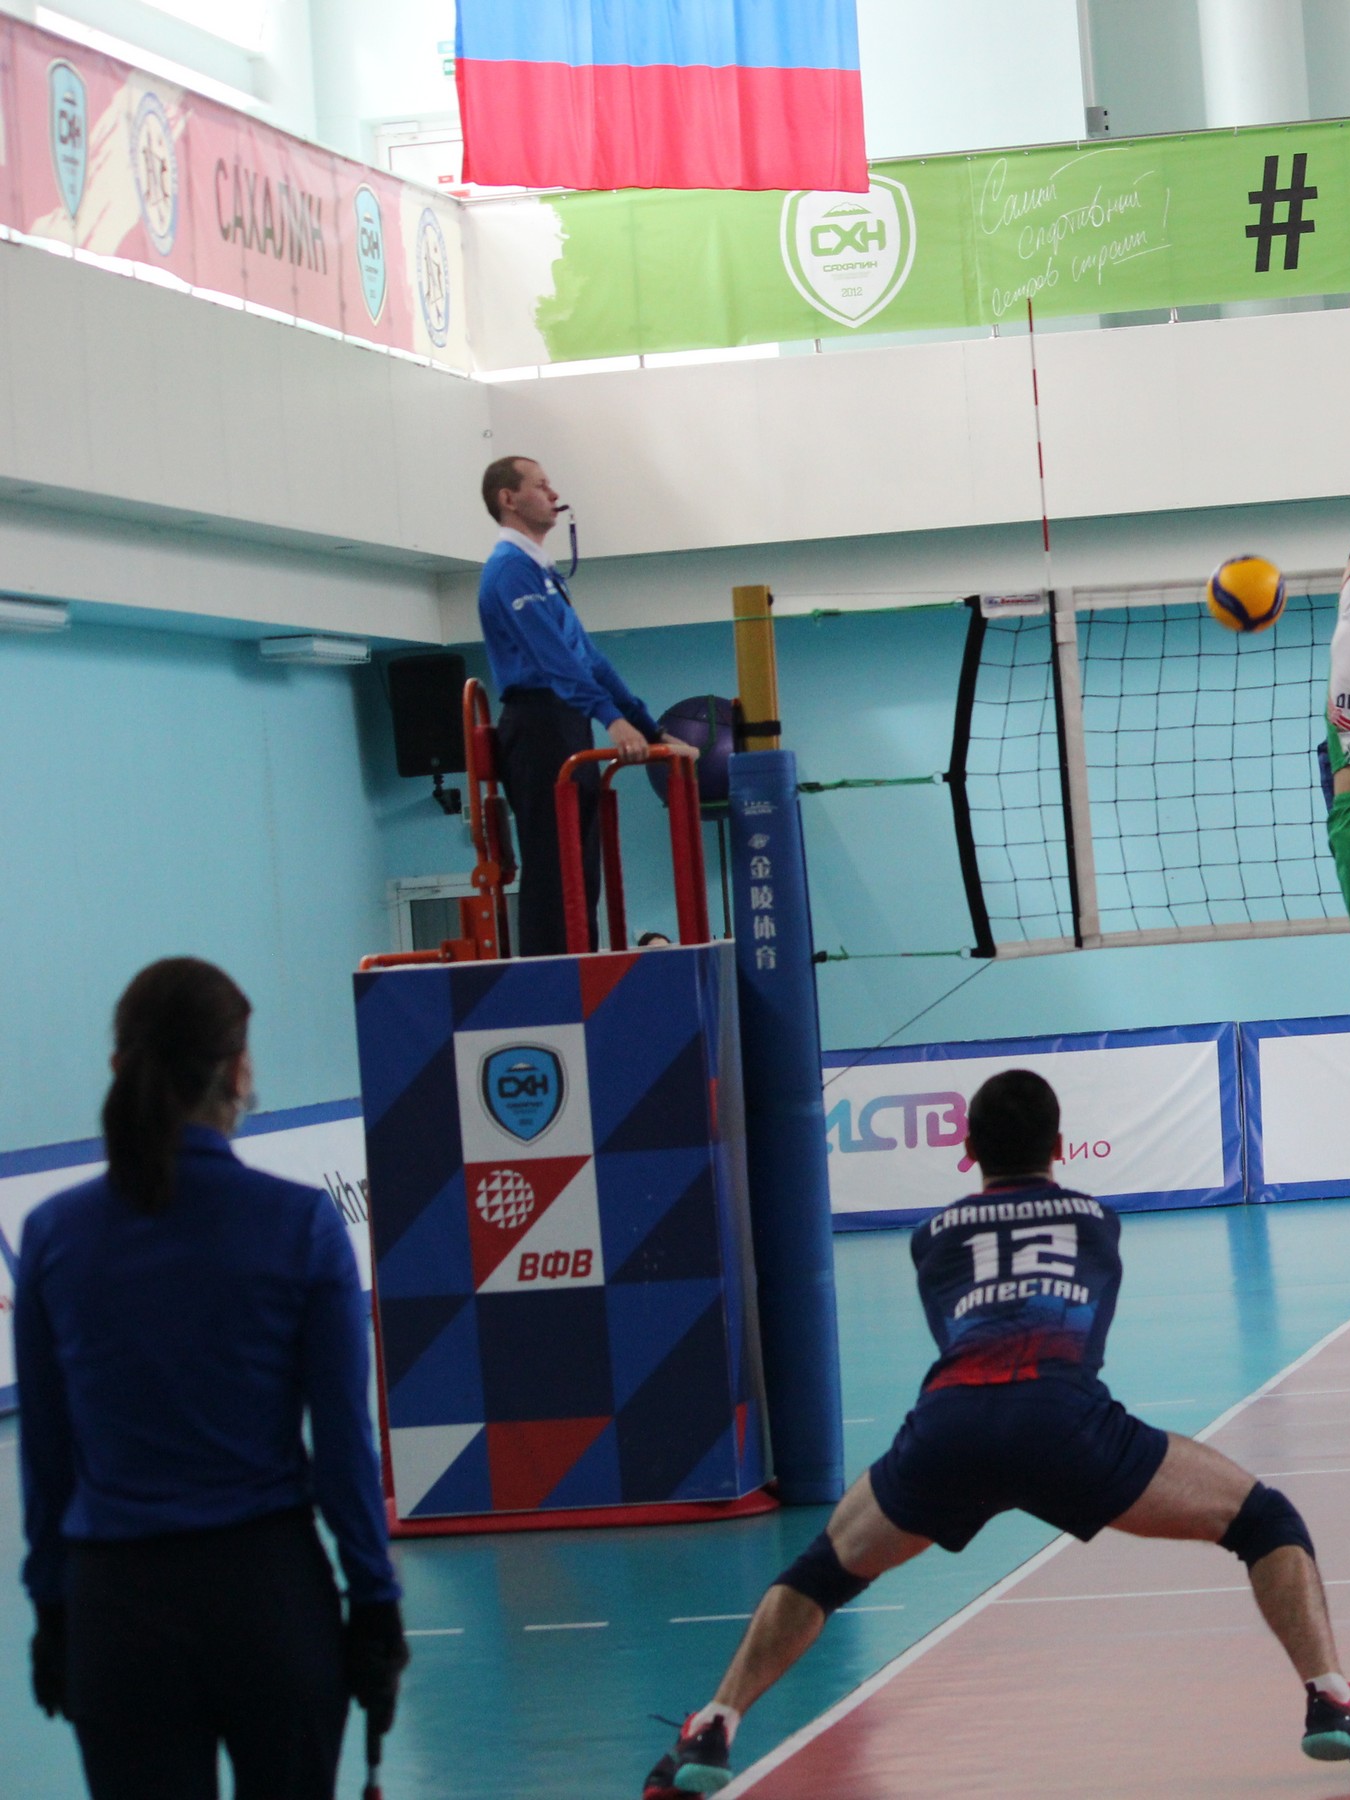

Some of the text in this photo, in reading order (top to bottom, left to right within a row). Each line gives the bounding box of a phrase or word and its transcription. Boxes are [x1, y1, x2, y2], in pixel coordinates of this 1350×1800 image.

[215, 158, 328, 275] САХАЛИН
[823, 261, 877, 272] САХАЛИН
[841, 287, 863, 298] 2012
[750, 855, 776, 970] 金陵体育
[517, 1248, 593, 1282] ВФВ
[962, 1223, 1078, 1284] 12
[954, 1277, 1090, 1320] ДАГЕСТАН
